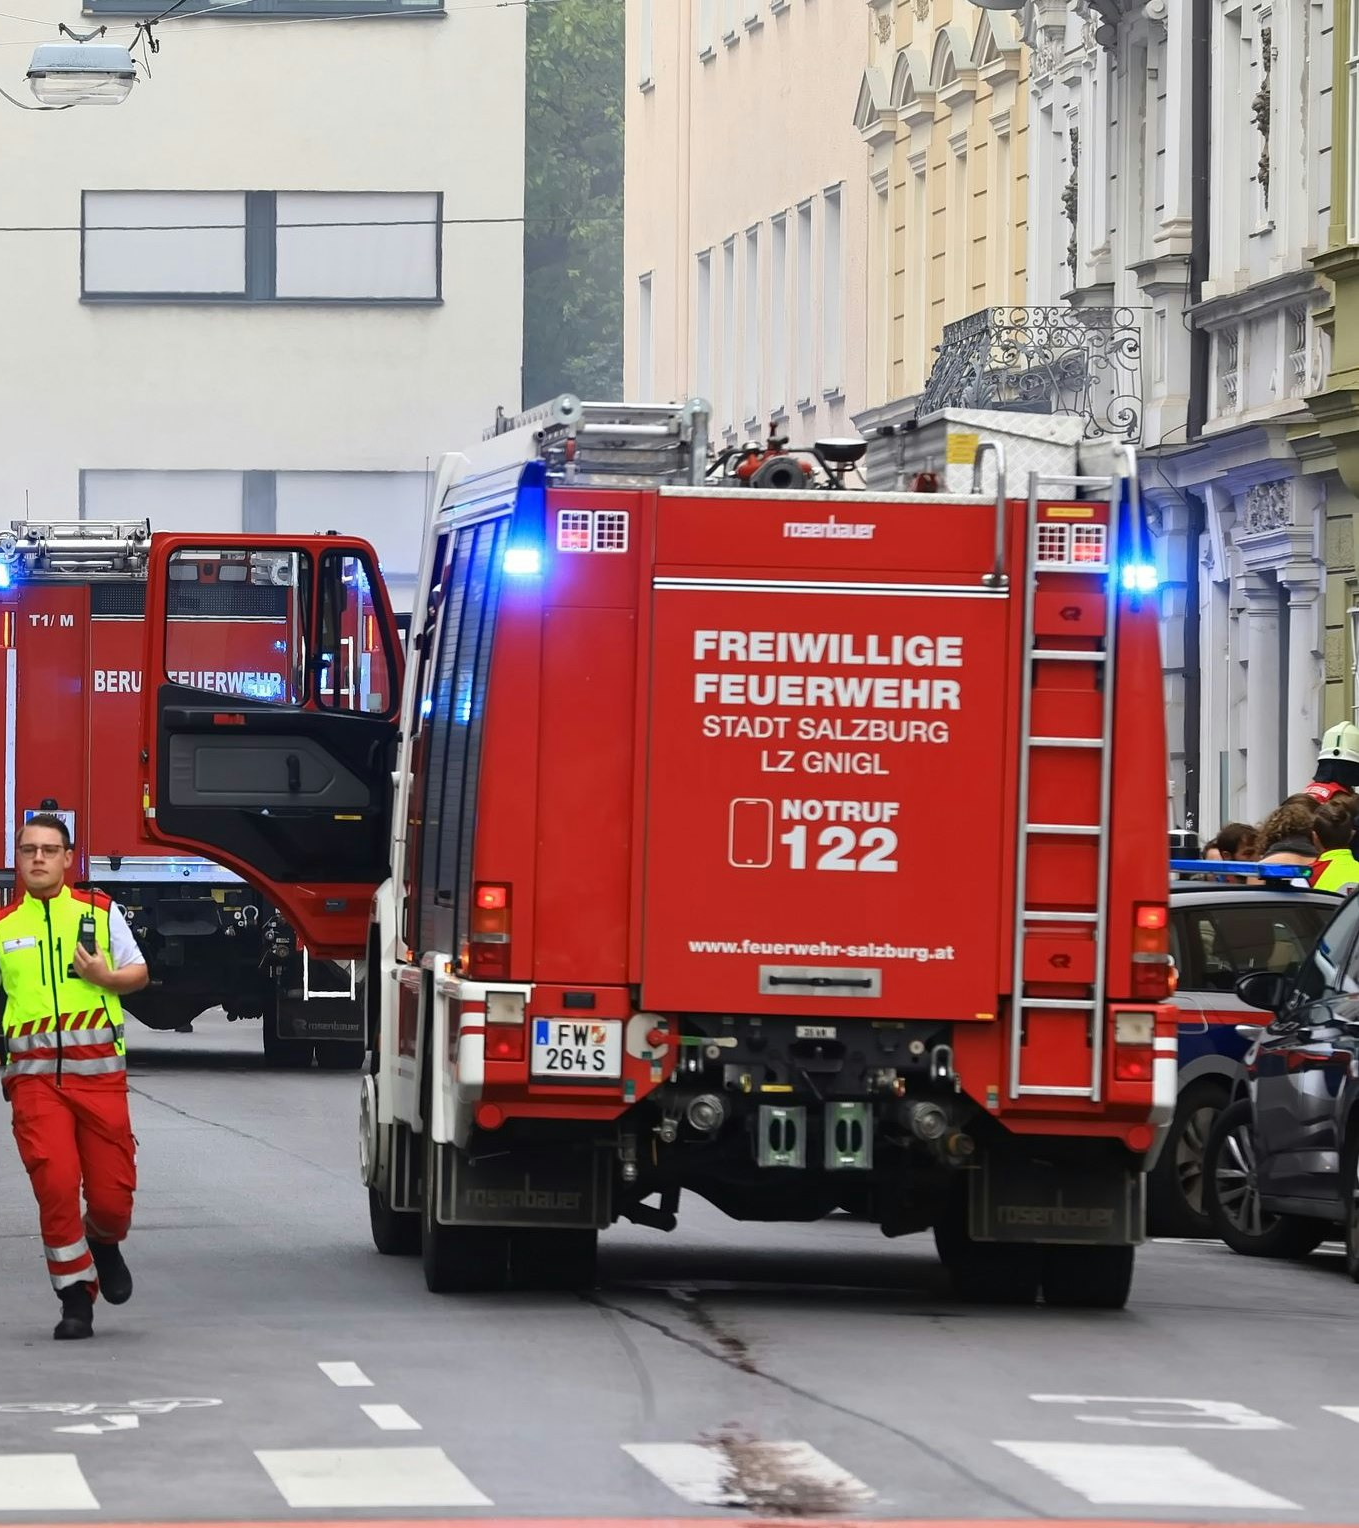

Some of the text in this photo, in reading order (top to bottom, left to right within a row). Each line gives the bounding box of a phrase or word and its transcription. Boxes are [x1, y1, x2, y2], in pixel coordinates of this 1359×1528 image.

[783, 515, 876, 539] rosenbauer
[60, 614, 73, 627] M
[693, 630, 963, 667] FREIWILLIGE
[694, 673, 961, 710] FEUERWEHR
[702, 714, 949, 743] STADT SALZBURG
[761, 750, 889, 775] LZ GNIGL
[780, 799, 900, 823] NOTRUF
[780, 825, 898, 872] 122
[688, 939, 955, 962] www.feuerwehr-salzburg.at
[558, 1024, 589, 1046] FW
[546, 1048, 605, 1071] 264 S
[465, 1173, 582, 1209] rosenbauer
[997, 1189, 1114, 1226] rosenbauer
